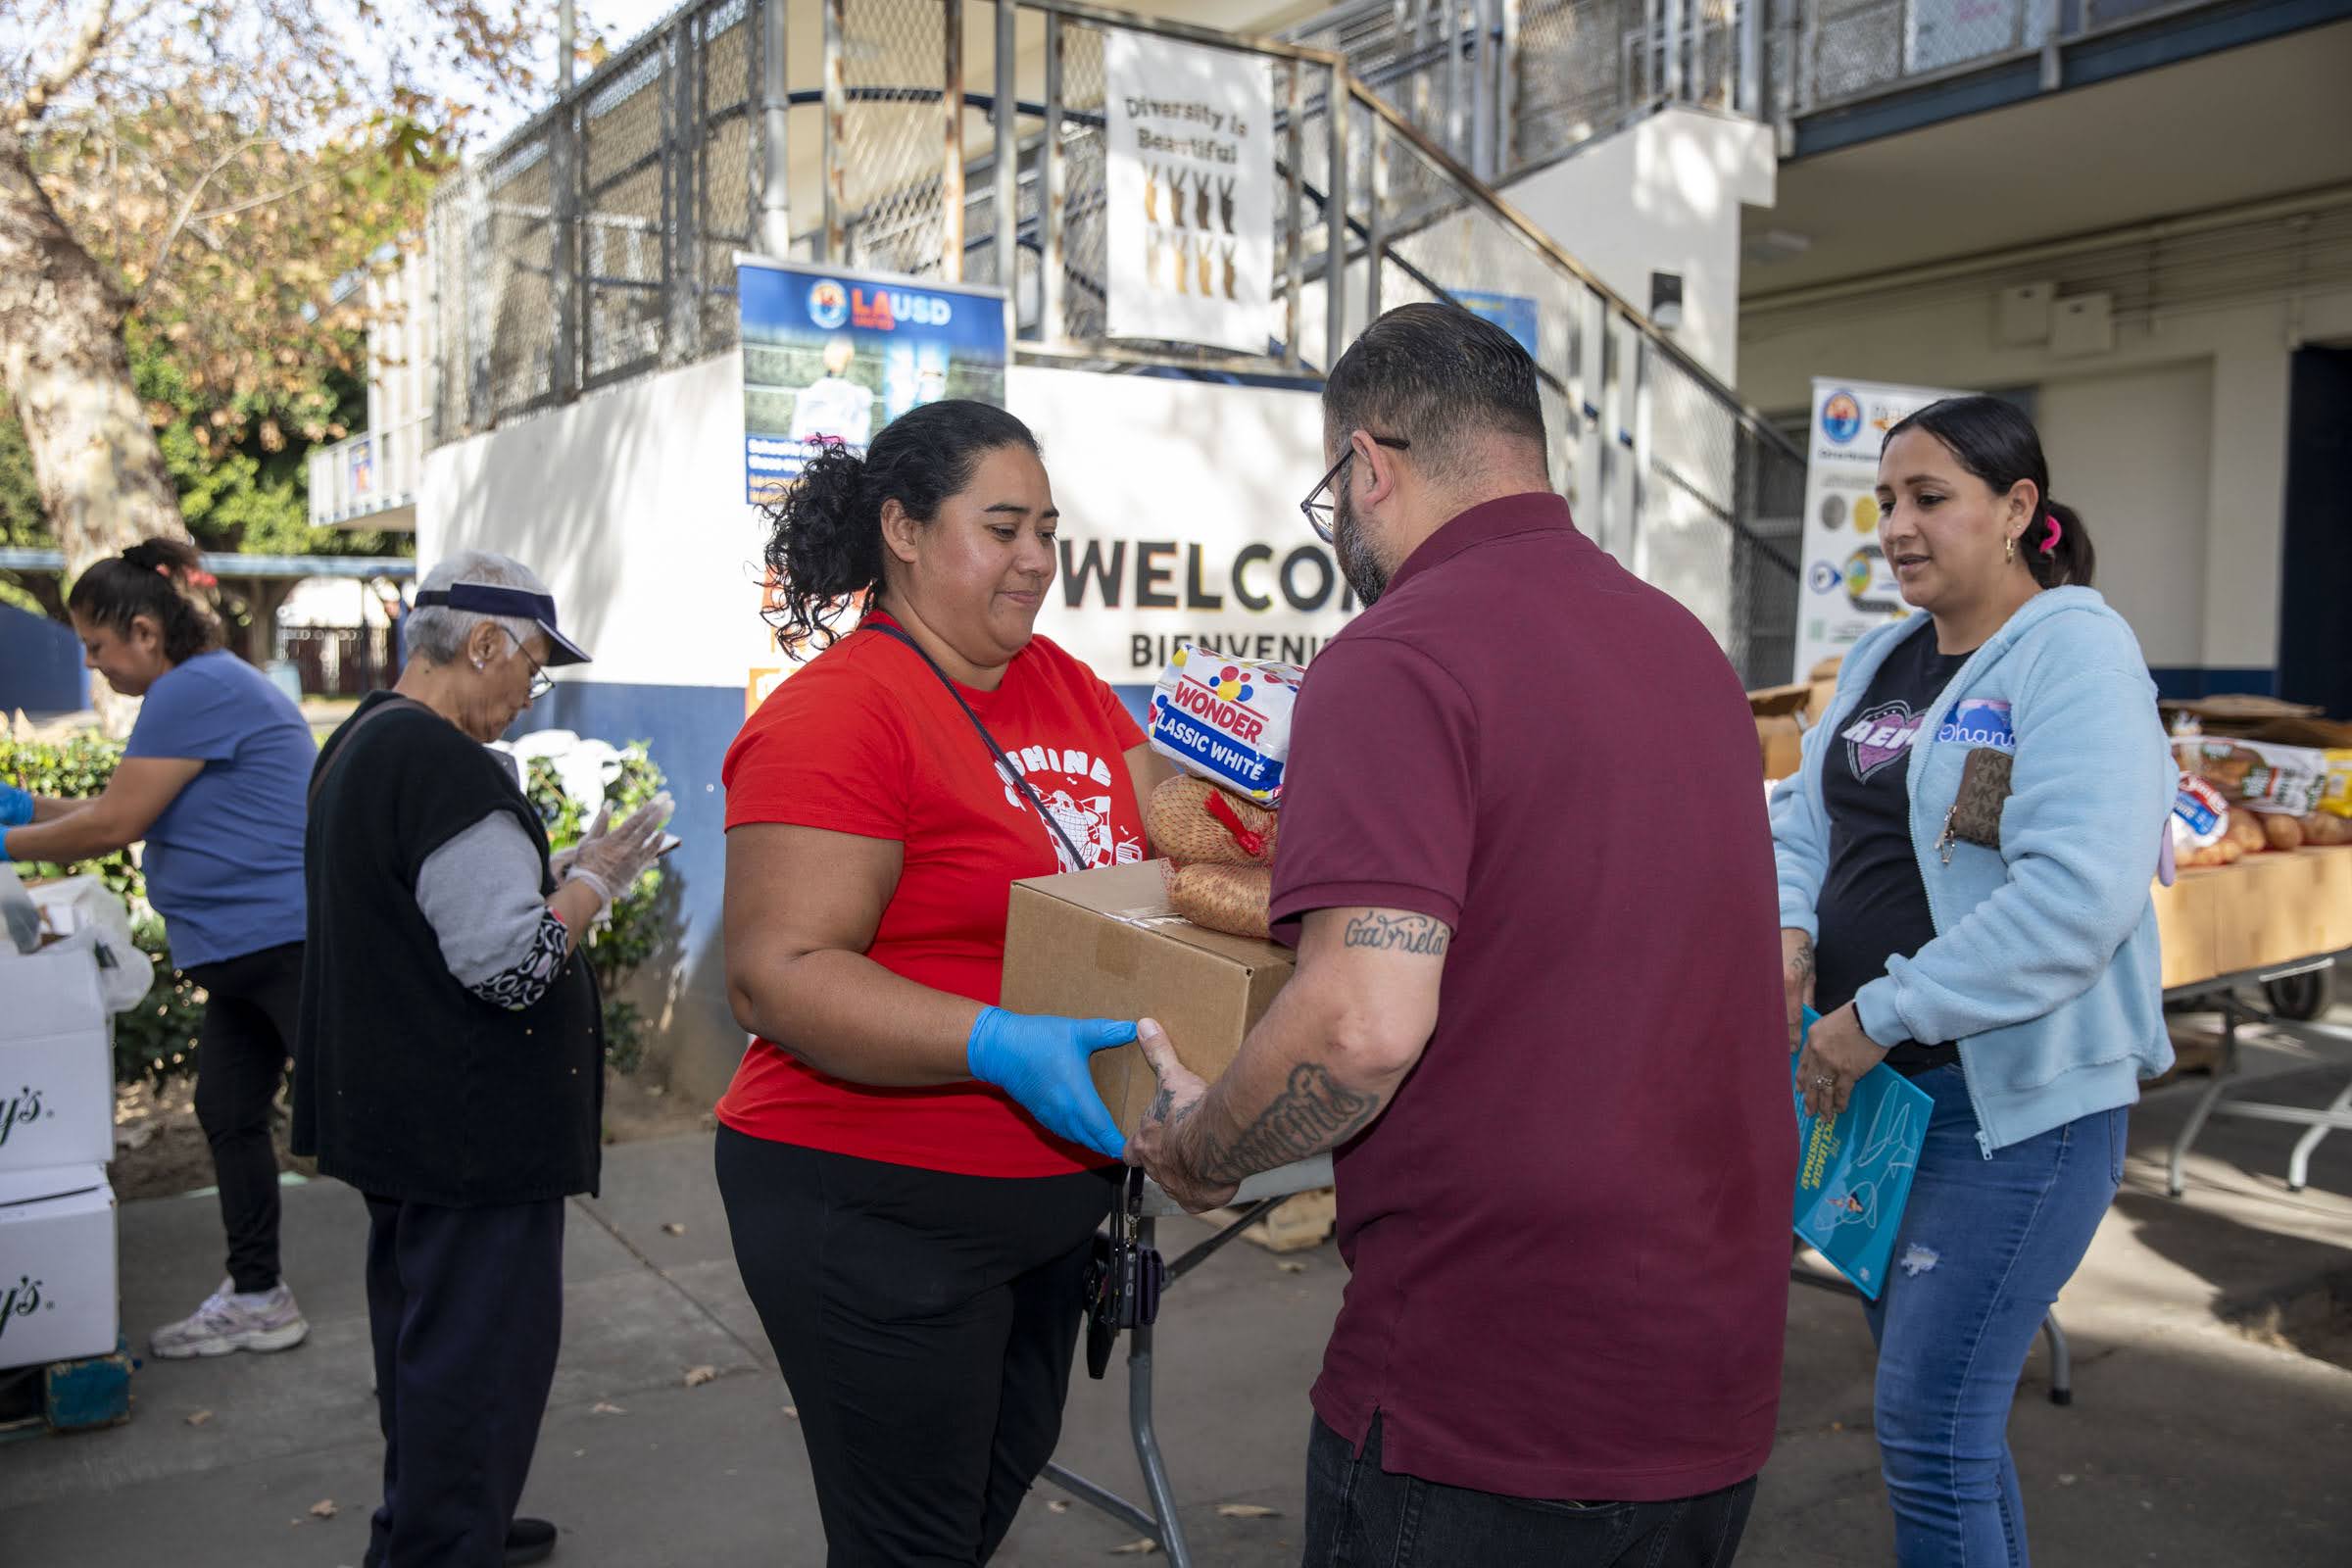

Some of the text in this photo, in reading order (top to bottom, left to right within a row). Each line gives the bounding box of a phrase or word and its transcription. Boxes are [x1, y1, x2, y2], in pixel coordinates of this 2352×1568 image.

[1126, 97, 1223, 131] Diversity
[1137, 127, 1238, 166] Beautiful
[852, 288, 953, 326] LAUSD
[1059, 539, 1354, 612] WELCO
[1132, 633, 1330, 668] BIENVENI
[1175, 680, 1263, 745] WONDER
[1156, 712, 1266, 781] LASSIC WHITE
